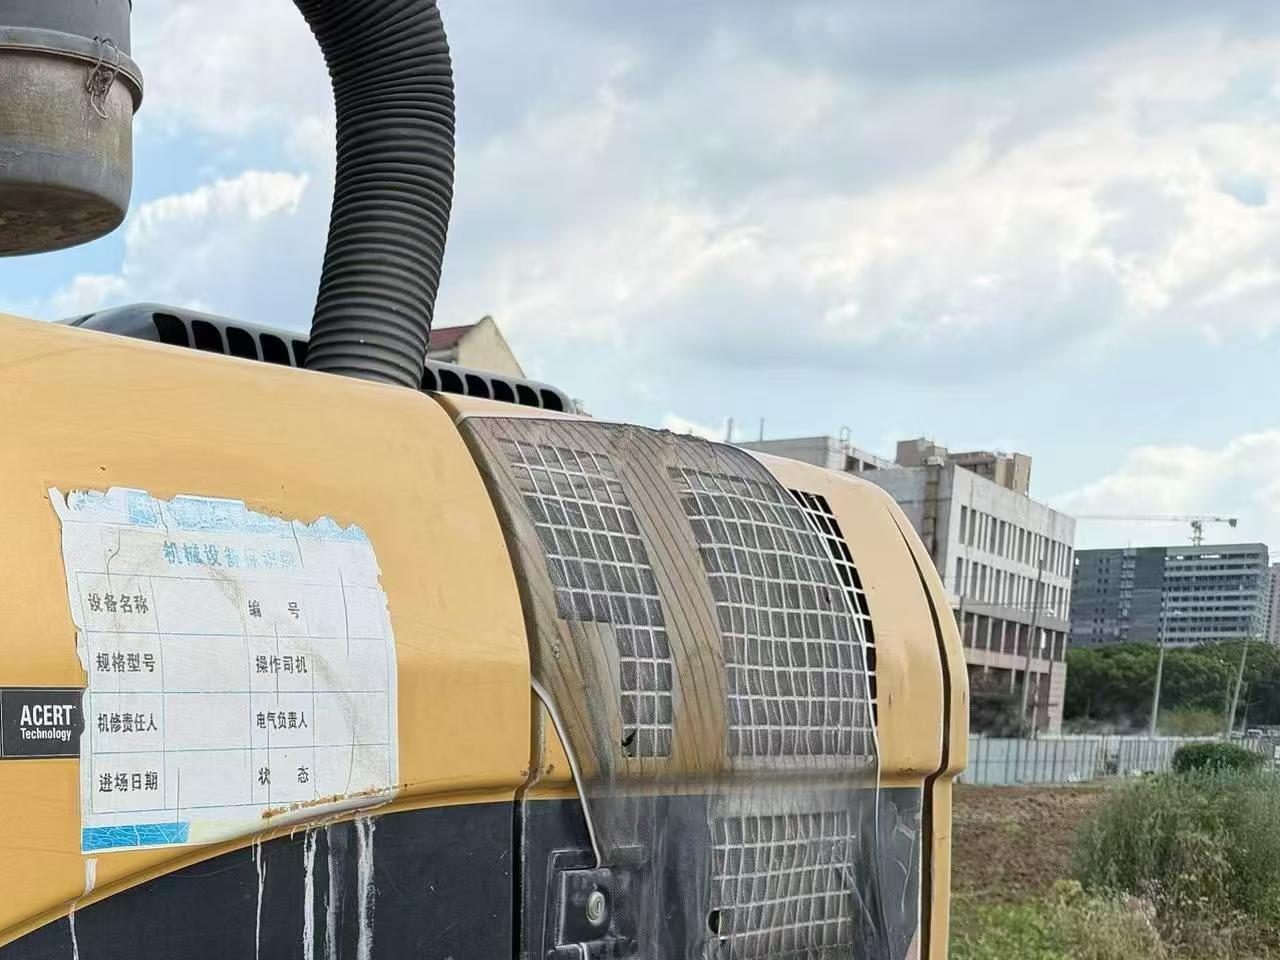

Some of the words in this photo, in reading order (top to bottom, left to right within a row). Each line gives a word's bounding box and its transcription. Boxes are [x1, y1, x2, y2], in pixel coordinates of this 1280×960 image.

[87, 592, 149, 614] 设备名称
[95, 652, 156, 673] 规格型号
[255, 655, 308, 675] 操作司机
[20, 704, 73, 726] ACERT
[97, 712, 158, 734] 机修责任人
[256, 711, 308, 730] 电气负责人
[20, 727, 72, 742] Technology
[98, 770, 159, 792] 进场日期
